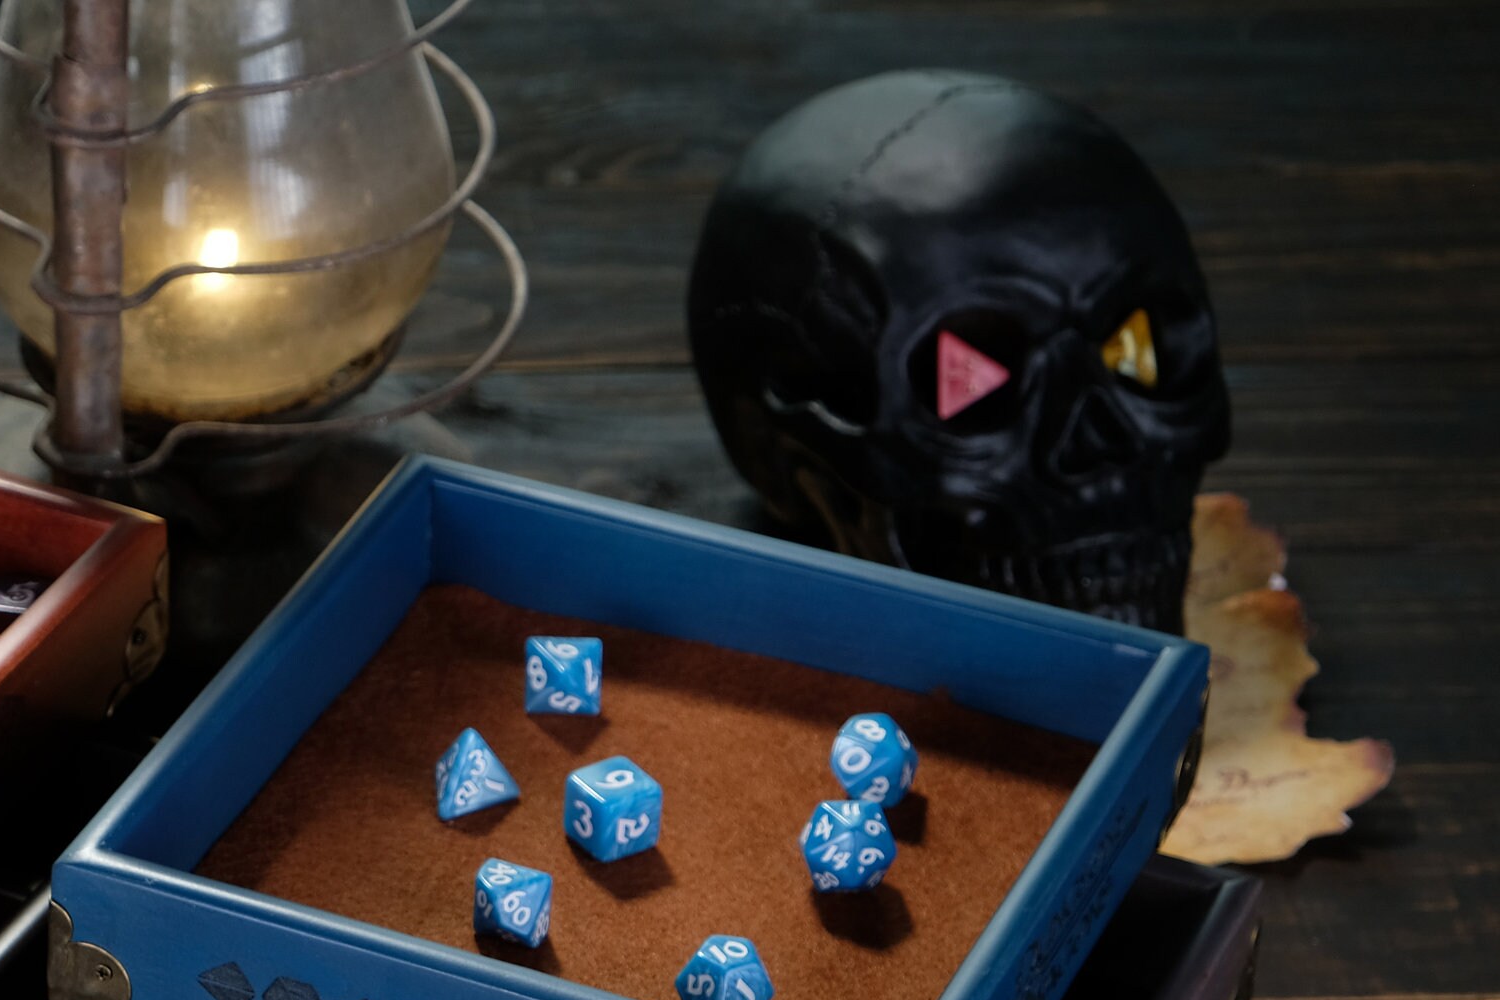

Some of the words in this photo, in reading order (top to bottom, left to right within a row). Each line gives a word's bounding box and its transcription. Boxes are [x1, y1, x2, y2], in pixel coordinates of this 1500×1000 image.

[468, 749, 486, 776] 3
[573, 800, 593, 838] 3
[502, 890, 531, 926] 60
[708, 940, 749, 964] 10
